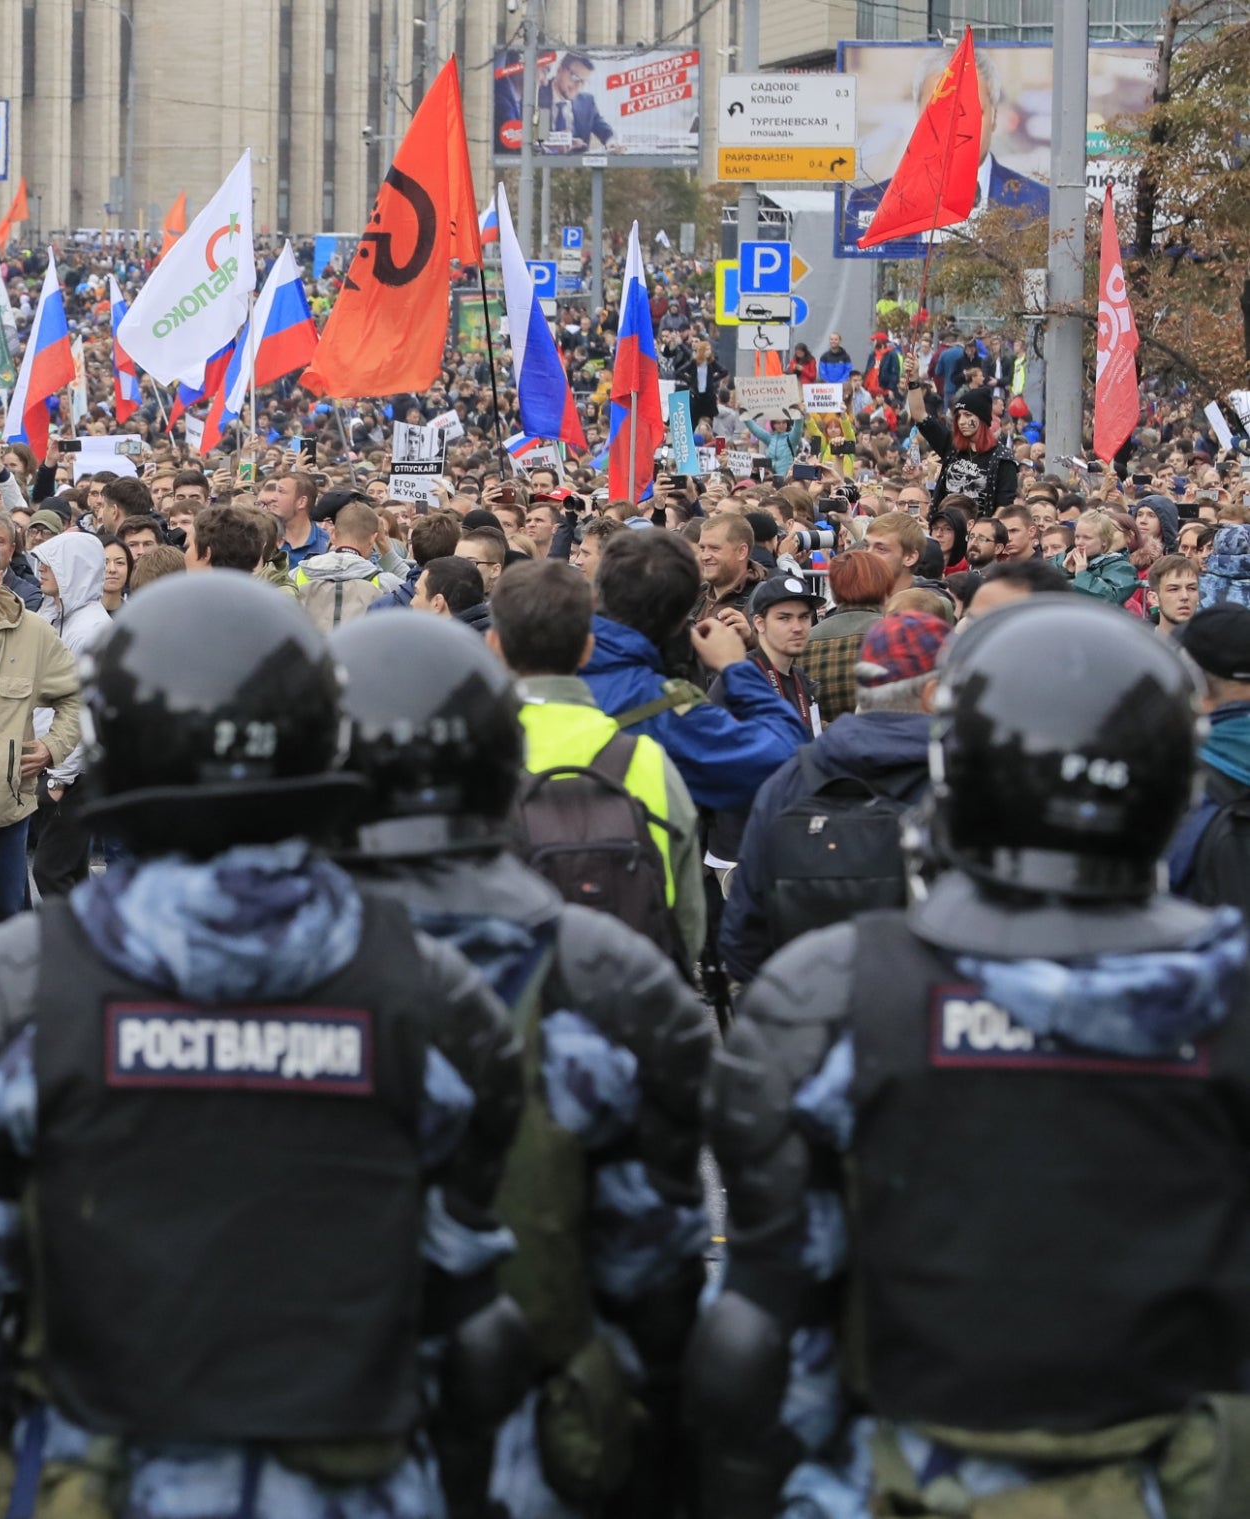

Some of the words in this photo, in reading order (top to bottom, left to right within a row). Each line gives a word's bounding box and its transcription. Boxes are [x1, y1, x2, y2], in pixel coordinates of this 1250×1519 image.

[628, 57, 683, 81] ПЕРЕКУР
[652, 73, 680, 90] ШАГ
[751, 82, 800, 92] САДОВОЕ
[835, 89, 850, 98] 0.3
[627, 102, 637, 114] К
[638, 87, 686, 112] УСПЕХУ
[751, 95, 793, 105] КОЛЬЦО
[751, 117, 829, 127] ТУРГЕНЕВСКАЯ
[835, 123, 841, 132] 1
[750, 129, 794, 138] площадь
[725, 152, 794, 162] РАЙФФАЙЗЕН
[725, 166, 751, 175] БАНК
[567, 228, 579, 247] P
[753, 246, 782, 288] P
[741, 386, 787, 397] МОСКВА
[813, 394, 833, 402] ПРАВО
[394, 462, 437, 474] ОТПУСКАЙ!
[393, 479, 417, 489] ЕГОР
[393, 488, 428, 500] ЖУКОВ
[118, 1017, 362, 1080] РОСГВАРДИЯ
